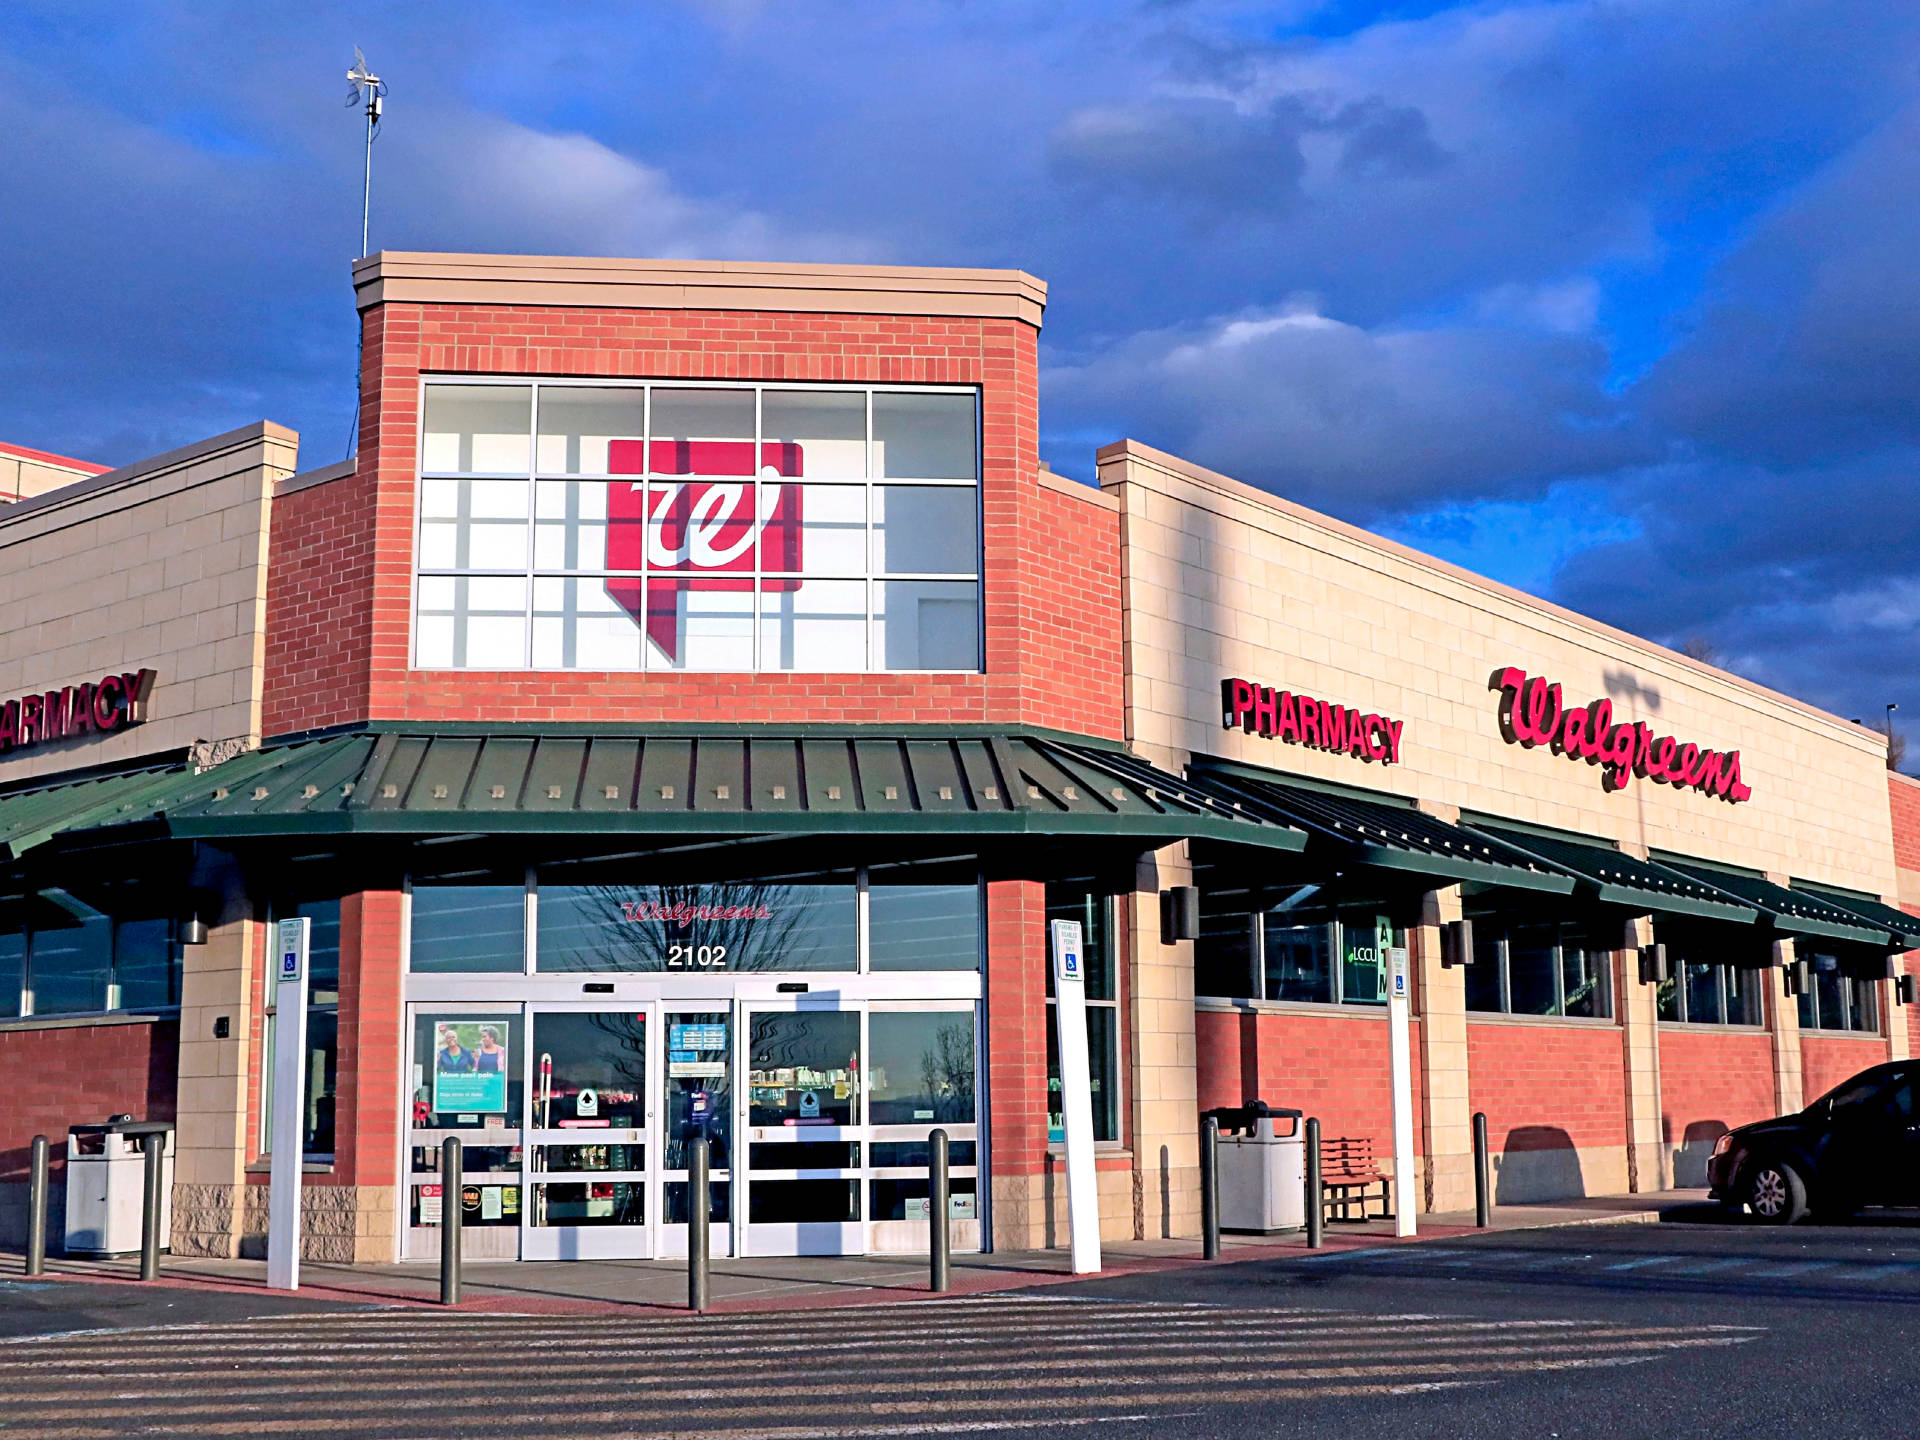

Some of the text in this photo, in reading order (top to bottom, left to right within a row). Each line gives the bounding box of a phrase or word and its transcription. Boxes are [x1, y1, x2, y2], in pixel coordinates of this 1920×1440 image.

[1222, 677, 1403, 766] PHARMACY
[1489, 666, 1753, 804] Walgreens
[620, 901, 773, 928] Walgreens
[668, 945, 726, 966] 2102
[1353, 946, 1377, 962] LCCU
